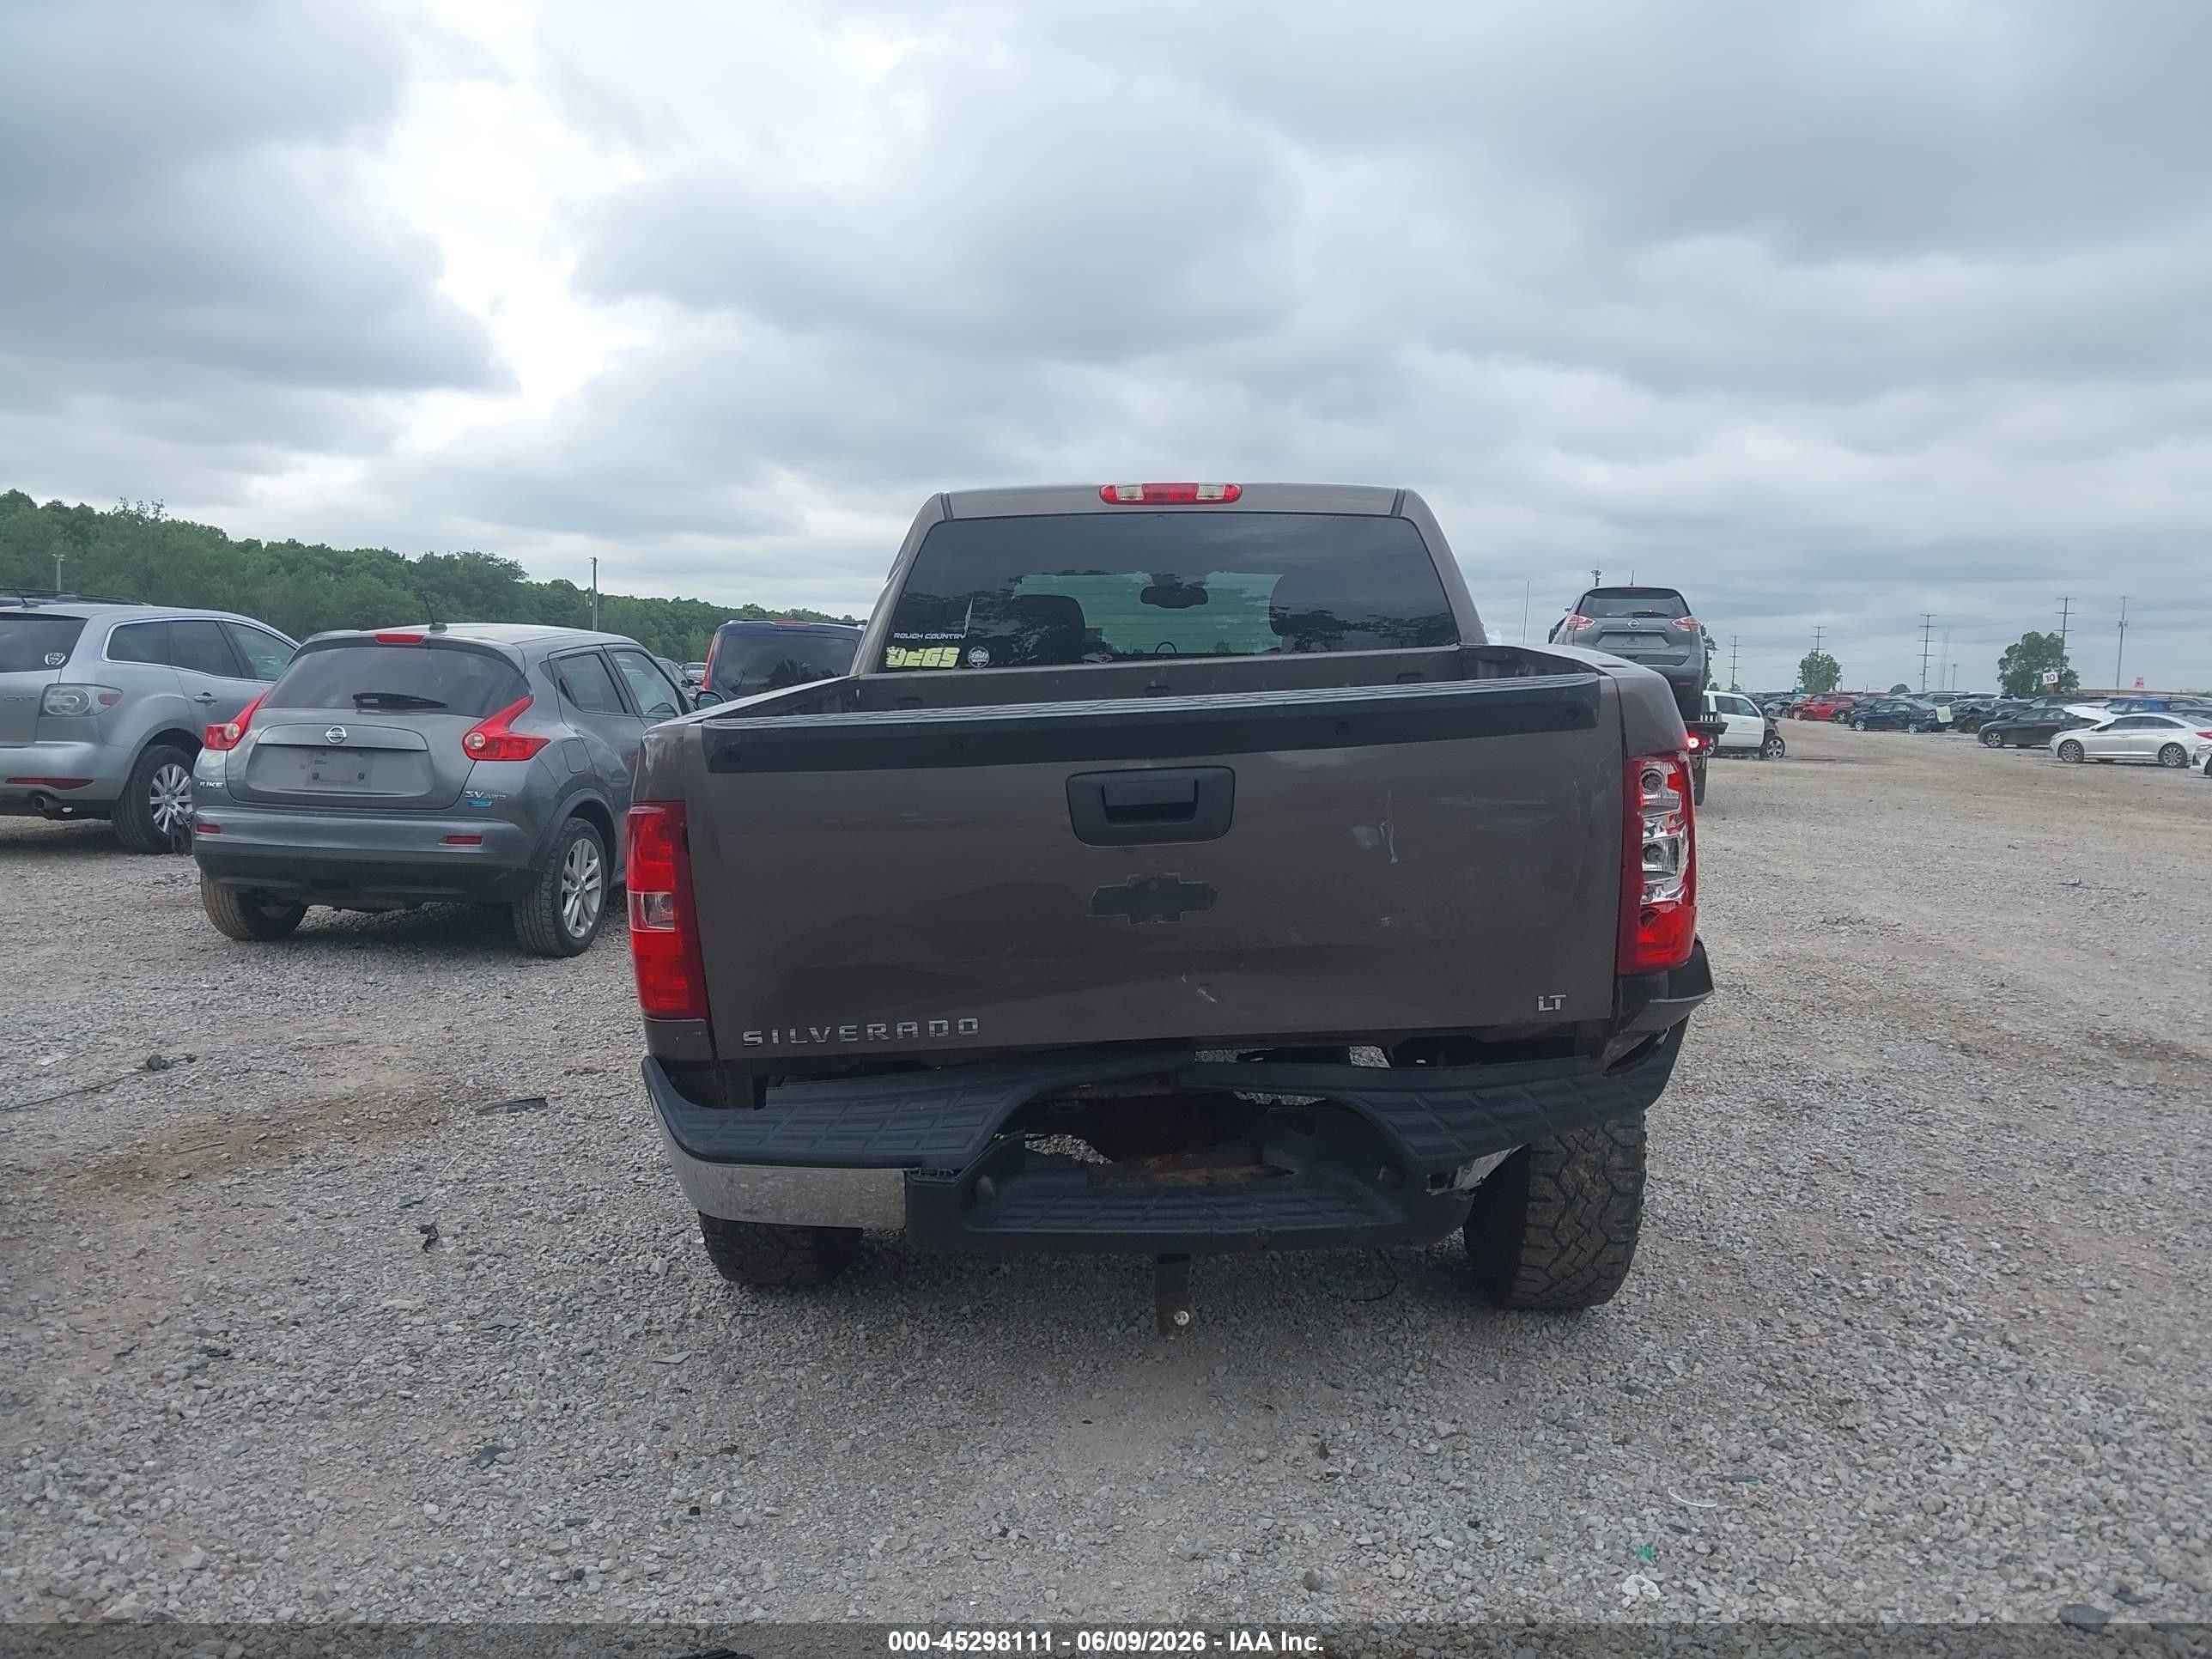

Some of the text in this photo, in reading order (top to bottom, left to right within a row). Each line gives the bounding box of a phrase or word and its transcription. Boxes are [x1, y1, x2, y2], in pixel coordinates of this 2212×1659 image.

[2045, 673, 2056, 683] 10
[199, 781, 223, 789] JUKE
[465, 790, 484, 799] SV
[1538, 994, 1567, 1012] LT
[742, 1018, 979, 1046] SILVERADO
